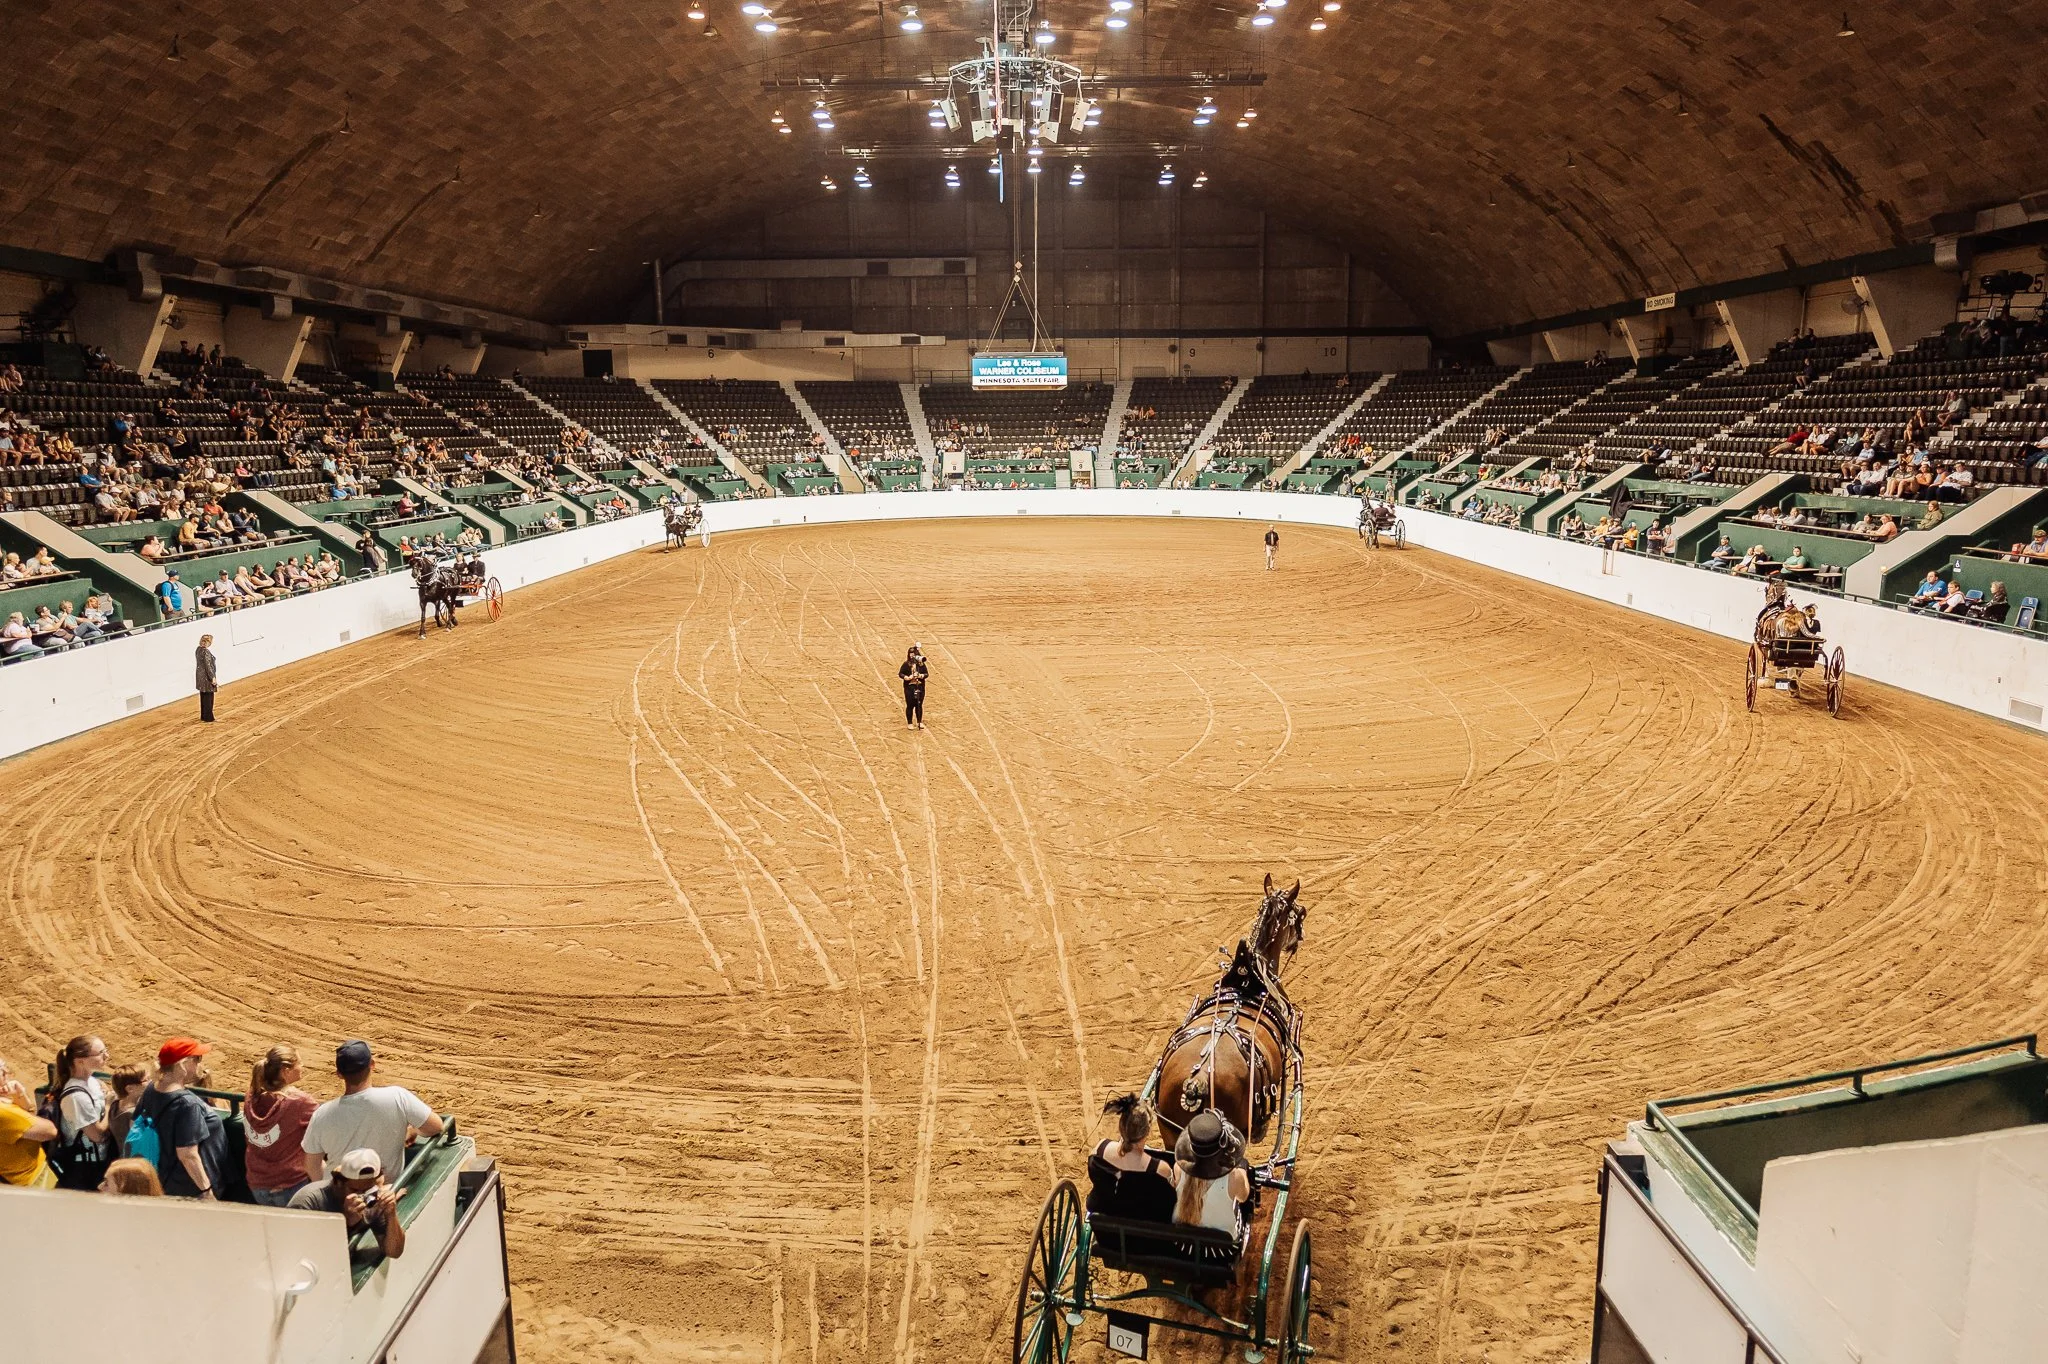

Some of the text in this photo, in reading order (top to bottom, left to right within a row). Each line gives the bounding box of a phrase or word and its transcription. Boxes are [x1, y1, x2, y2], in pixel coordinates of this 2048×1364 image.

[1654, 296, 1674, 307] SMOKING
[708, 349, 715, 358] 6
[839, 351, 846, 360] 7
[1189, 348, 1196, 357] 9
[1324, 346, 1337, 357] 10
[997, 359, 1042, 367] Lee & Rose
[979, 367, 1060, 375] WARNER COLISEUM
[1116, 1334, 1133, 1349] 07
